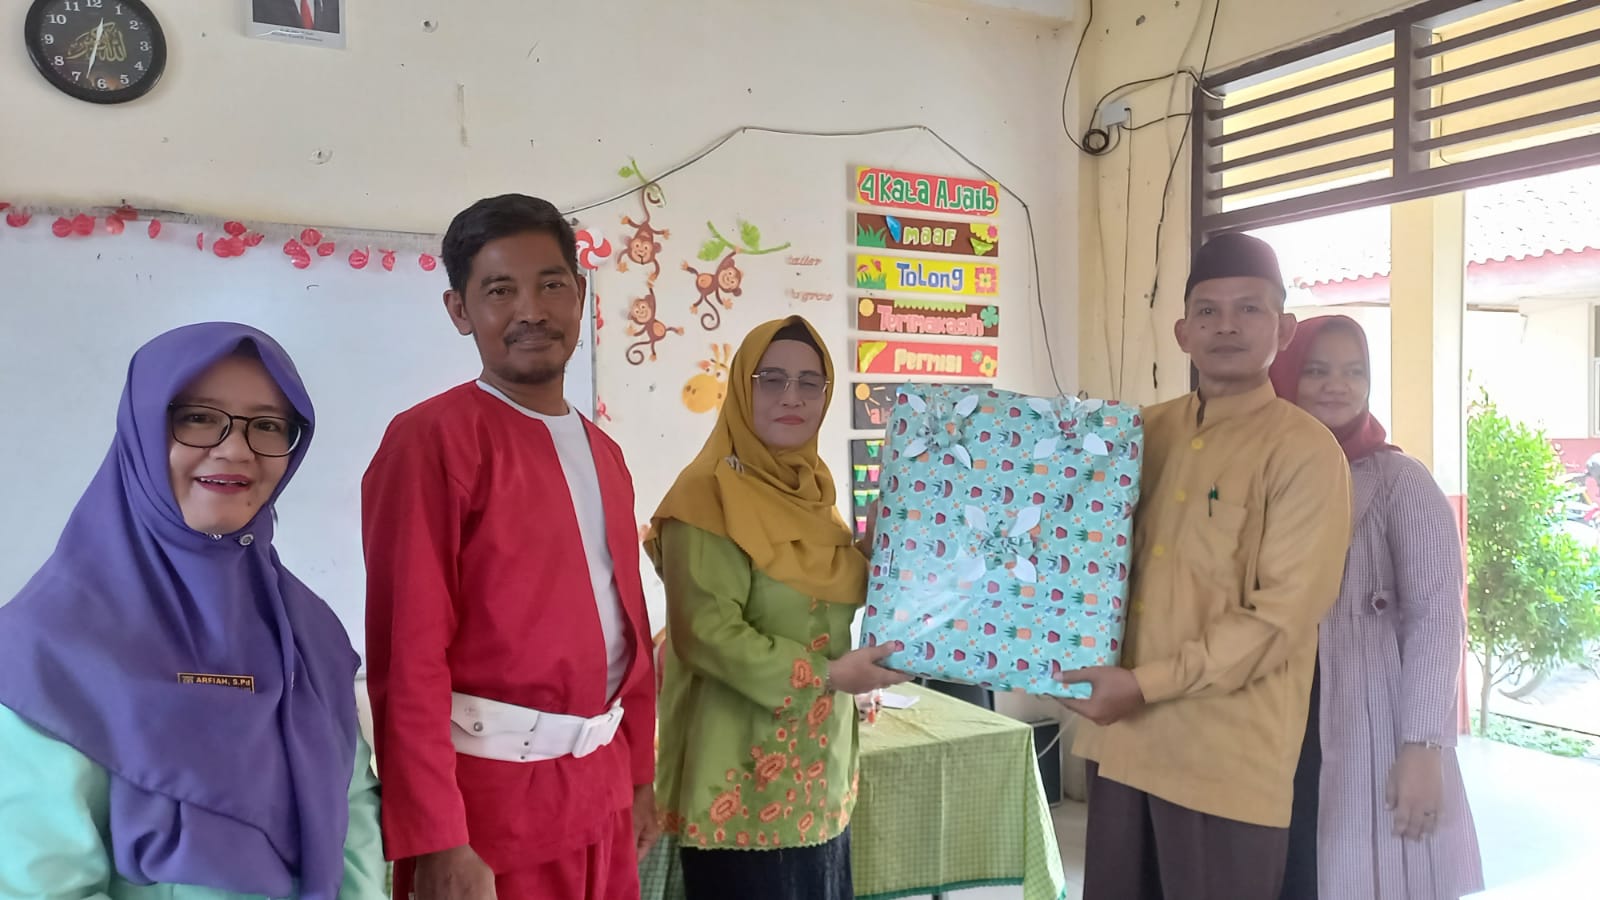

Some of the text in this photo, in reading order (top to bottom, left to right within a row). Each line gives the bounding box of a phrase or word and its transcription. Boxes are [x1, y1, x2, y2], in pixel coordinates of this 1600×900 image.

[64, 1, 80, 12] 11
[85, 0, 103, 8] 12
[114, 3, 123, 15] 1
[49, 14, 67, 25] 10
[129, 20, 139, 30] 2
[44, 34, 54, 45] 9
[140, 41, 149, 51] 3
[54, 55, 64, 66] 8
[134, 61, 143, 71] 4
[71, 71, 81, 81] 7
[120, 75, 129, 84] 5
[97, 79, 107, 89] 6
[860, 173, 875, 200] 4
[879, 173, 930, 206] Kata
